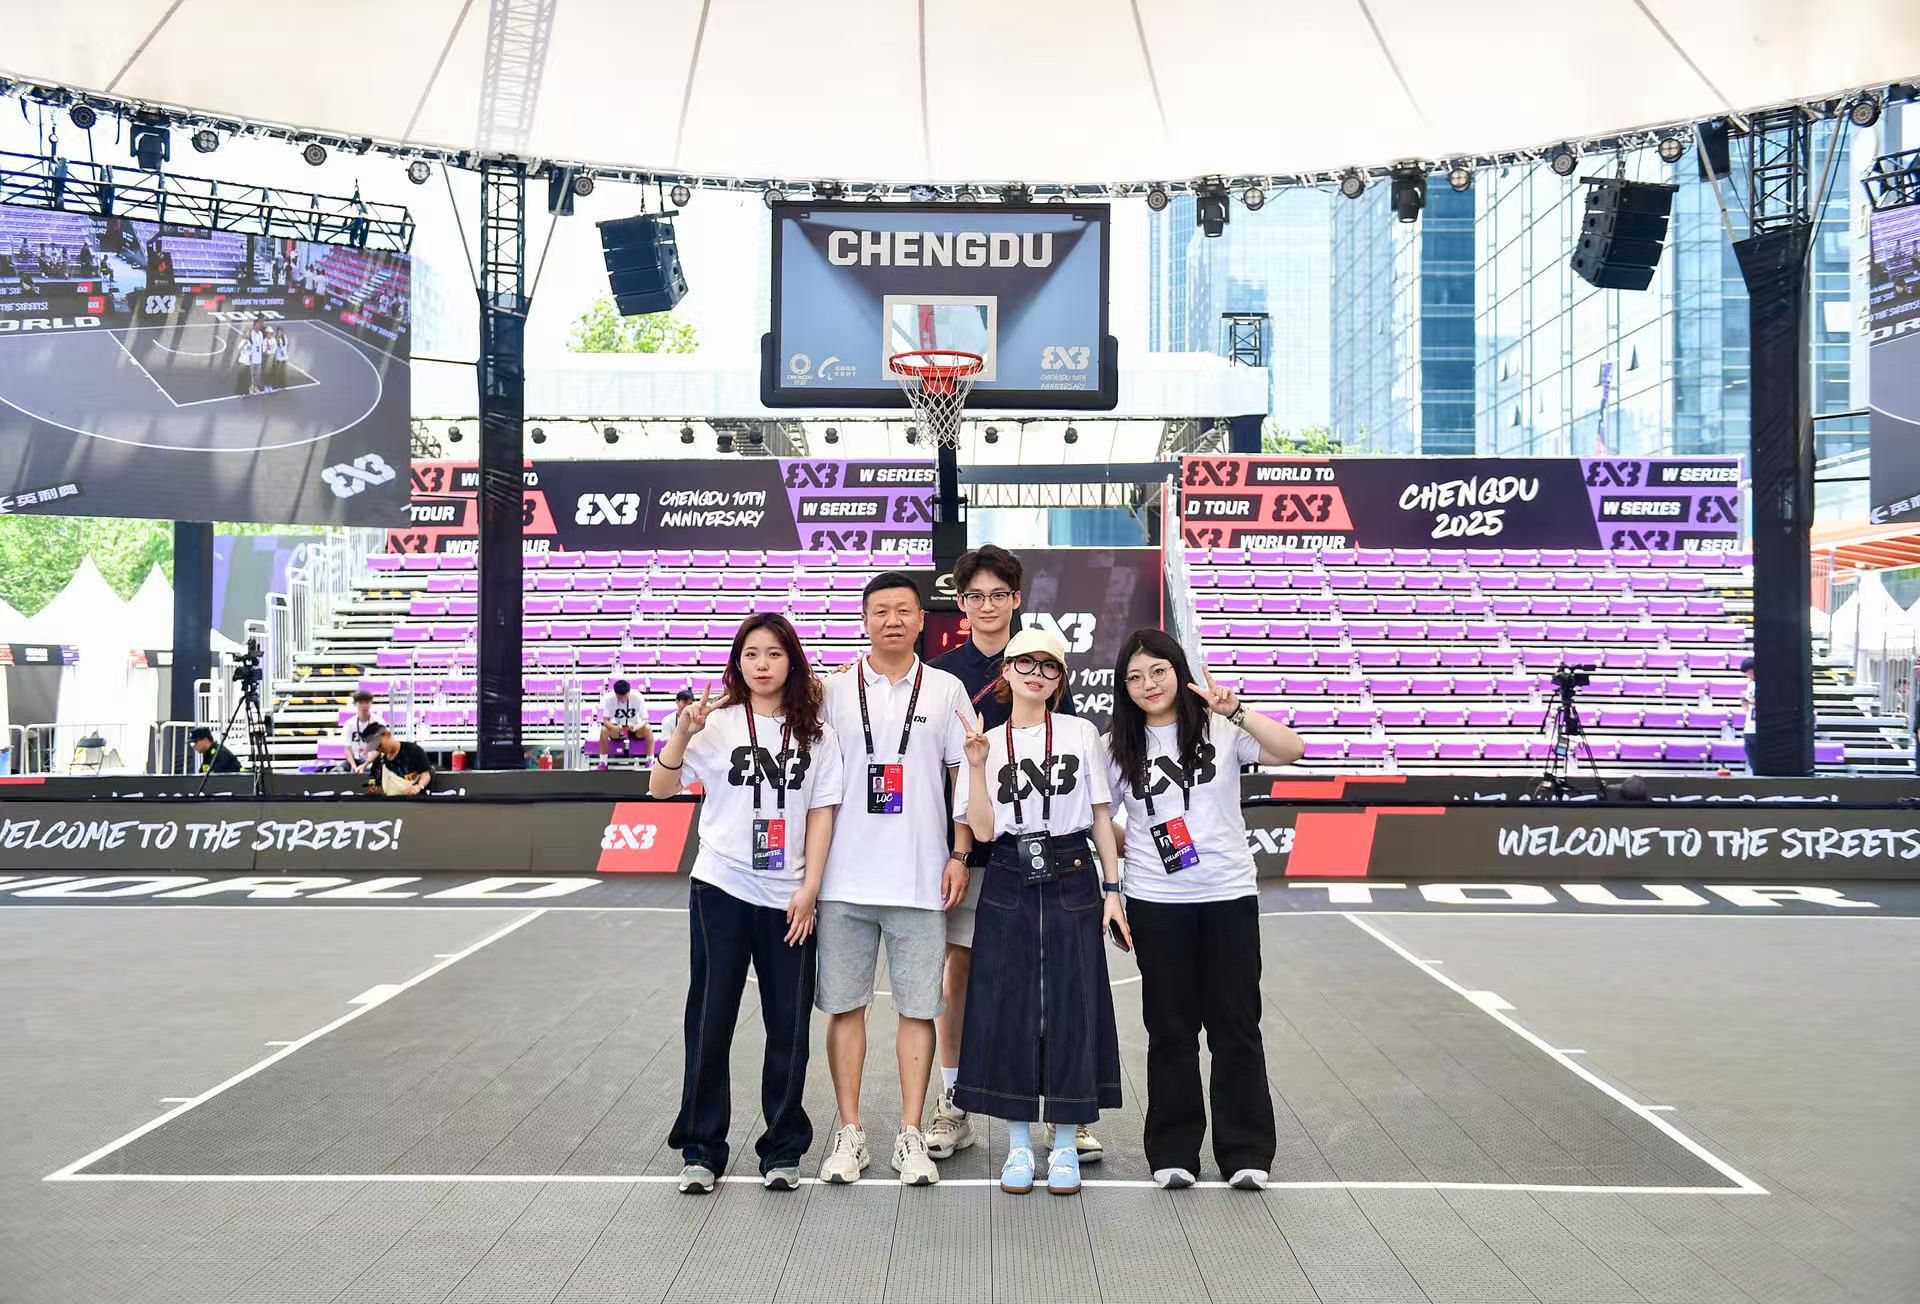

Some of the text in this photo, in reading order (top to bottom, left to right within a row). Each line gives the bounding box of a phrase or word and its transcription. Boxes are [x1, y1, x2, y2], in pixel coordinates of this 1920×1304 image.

[828, 230, 1053, 267] CHENGDU
[0, 316, 101, 331] ORLD
[859, 468, 875, 482] W
[877, 468, 935, 482] SERIES
[1257, 467, 1310, 482] WORLD
[1315, 467, 1335, 482] TO
[1662, 468, 1679, 482] W
[1679, 468, 1738, 482] SERIES
[659, 490, 766, 507] CHENGDU 10TH
[1399, 476, 1539, 512] CHENGDU
[575, 493, 640, 526] 3X3
[802, 502, 818, 516] W
[820, 502, 877, 516] SERIES
[1204, 500, 1250, 515] TOUR
[1603, 501, 1619, 516] W
[1621, 501, 1681, 516] SERIES
[660, 510, 765, 527] ANNIVERSARY
[1431, 509, 1505, 539] 2025
[1240, 535, 1298, 549] WORLD
[1301, 535, 1346, 549] TOUR
[876, 792, 894, 804] LOC
[0, 818, 403, 853] ELCOME TO THE STREETS!
[1498, 824, 1660, 859] WELCOME
[1660, 828, 1701, 857] TO
[1708, 827, 1778, 861] THE
[1288, 882, 1880, 908] TOUR
